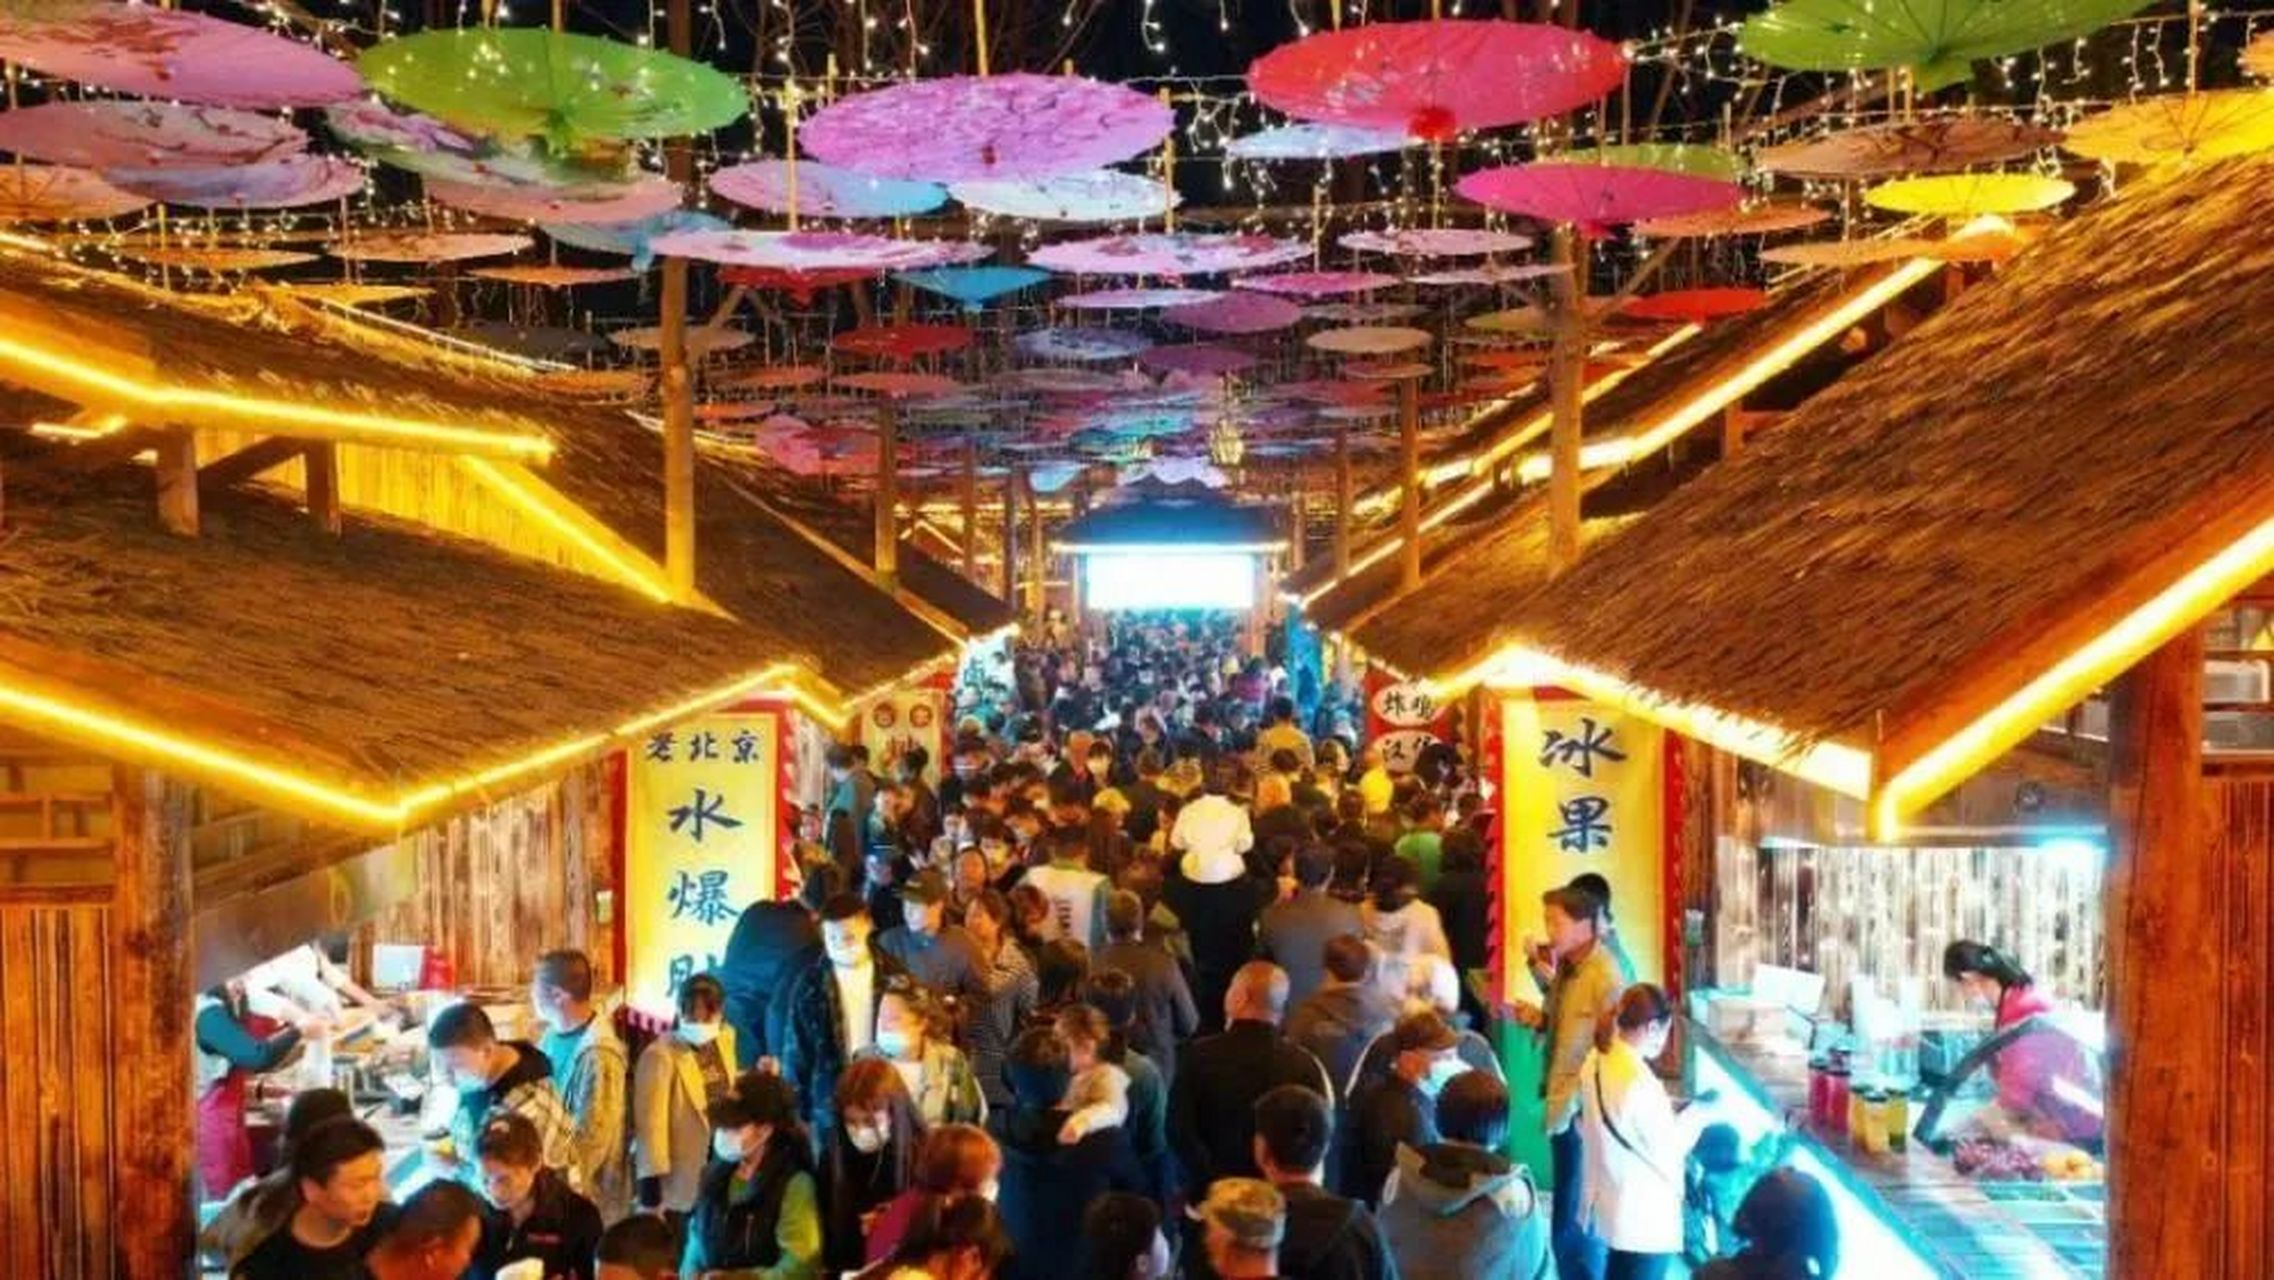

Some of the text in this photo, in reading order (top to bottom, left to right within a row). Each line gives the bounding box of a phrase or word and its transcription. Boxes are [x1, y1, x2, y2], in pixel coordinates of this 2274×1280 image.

[647, 730, 760, 763] 老北京
[1538, 717, 1628, 853] 冰果
